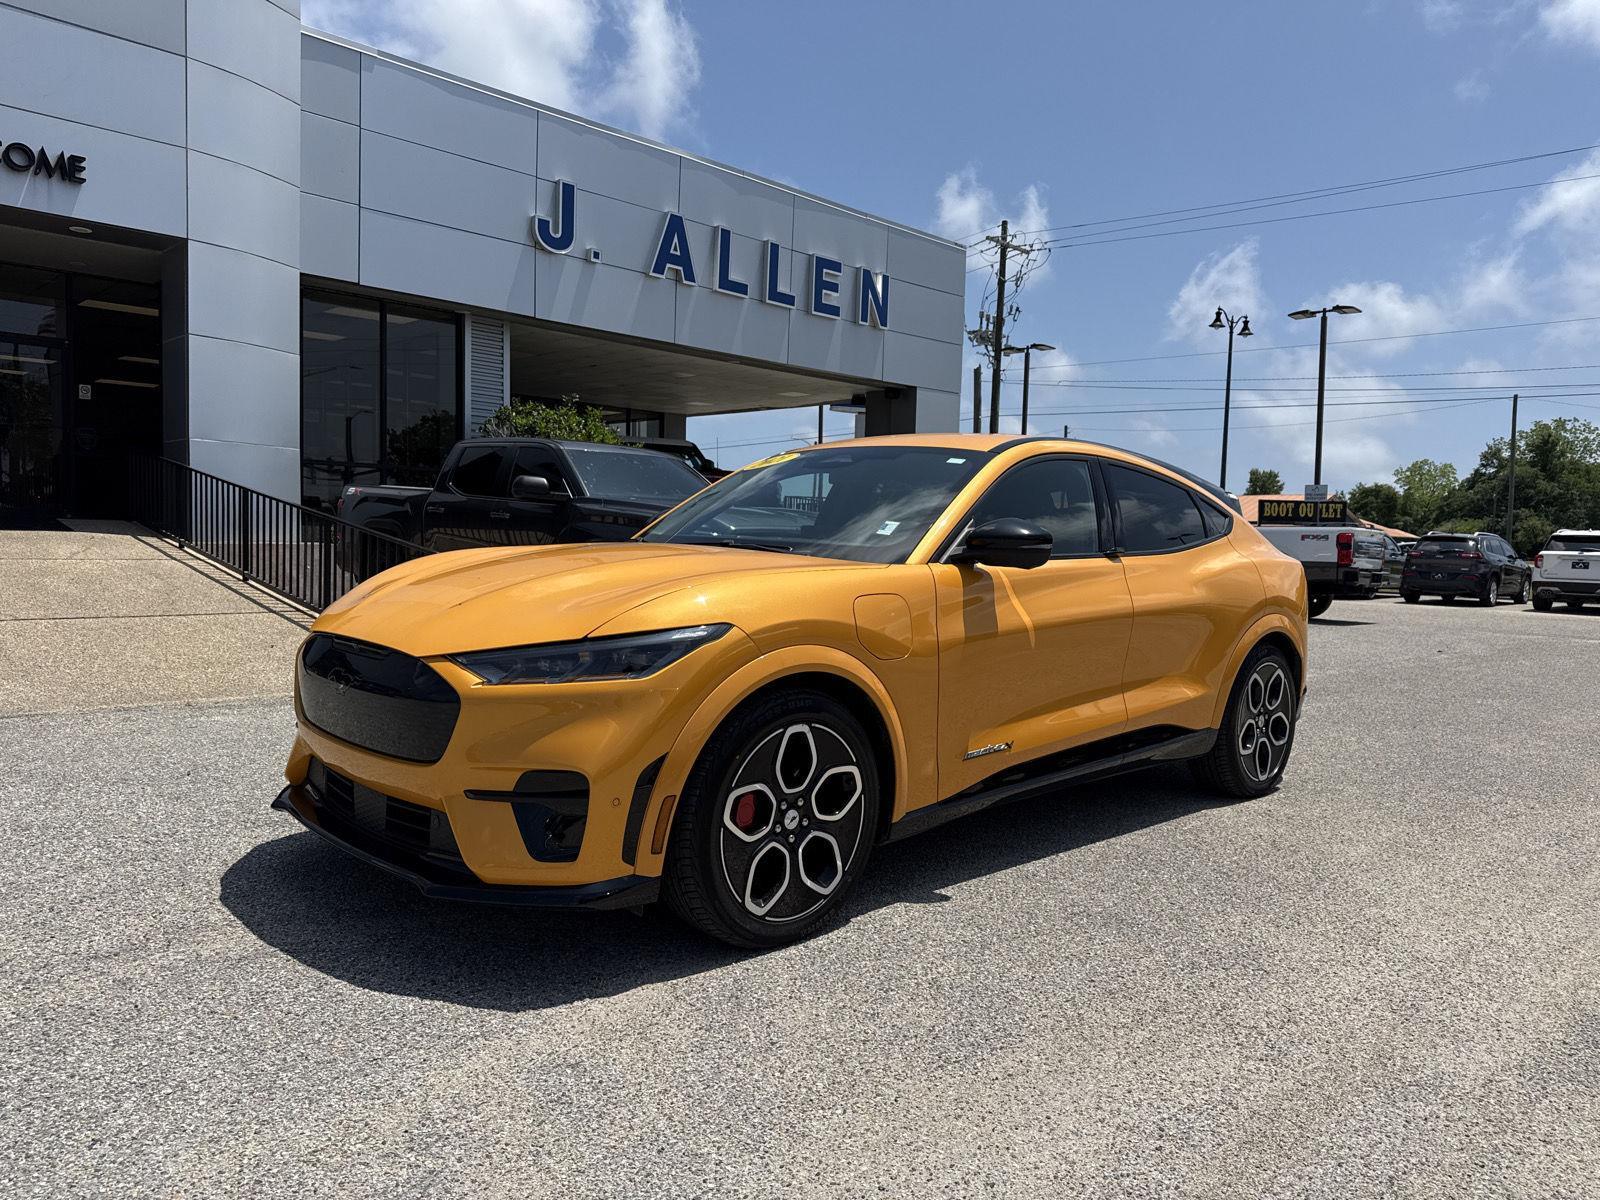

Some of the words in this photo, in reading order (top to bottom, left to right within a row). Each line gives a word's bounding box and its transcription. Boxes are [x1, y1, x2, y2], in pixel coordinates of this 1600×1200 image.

[0, 141, 87, 185] OME
[532, 178, 602, 263] J.
[648, 210, 891, 330] ALLEN
[1263, 502, 1295, 517] BOOT
[1298, 502, 1344, 518] OULET
